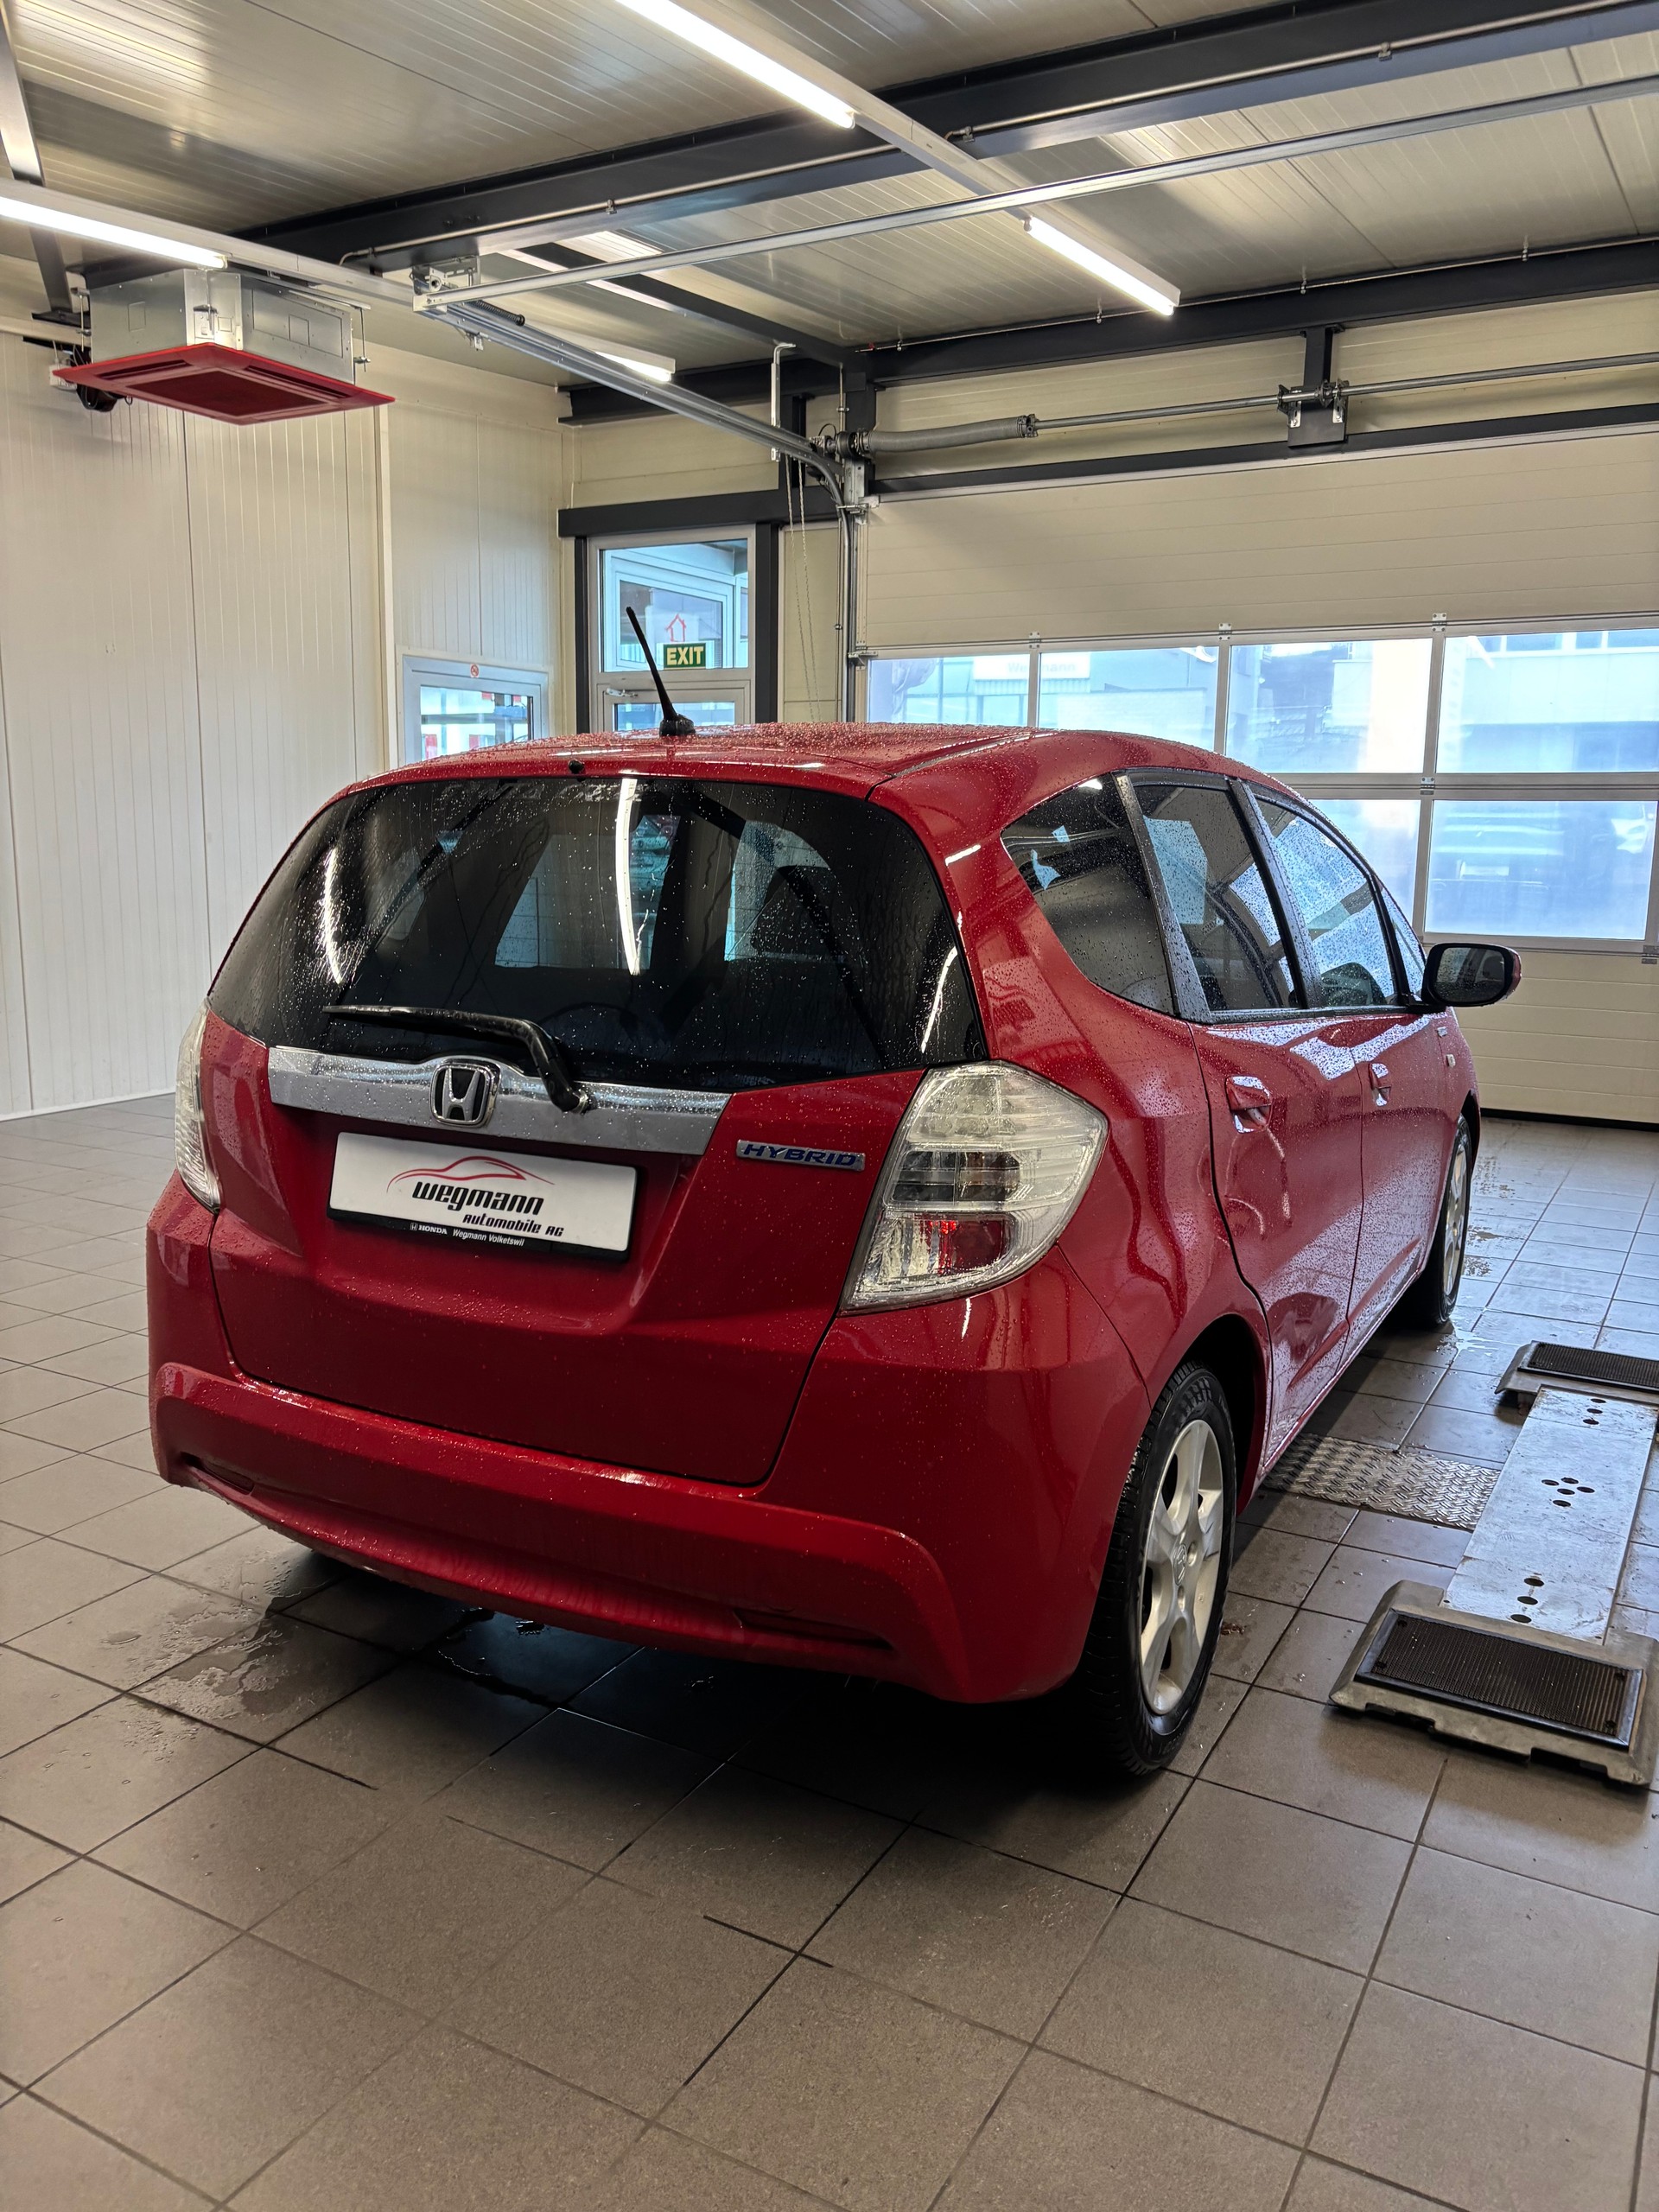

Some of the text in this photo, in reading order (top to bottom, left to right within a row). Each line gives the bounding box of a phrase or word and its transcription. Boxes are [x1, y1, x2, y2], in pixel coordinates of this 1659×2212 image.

[666, 645, 704, 665] EXIT
[1007, 662, 1076, 673] Wemann
[743, 1143, 857, 1166] HYBRID
[411, 1181, 544, 1216] wegmann
[418, 1224, 448, 1235] HONDA
[452, 1229, 487, 1241] Wegmann
[488, 1234, 524, 1247] Volketswil
[545, 1225, 564, 1236] AG
